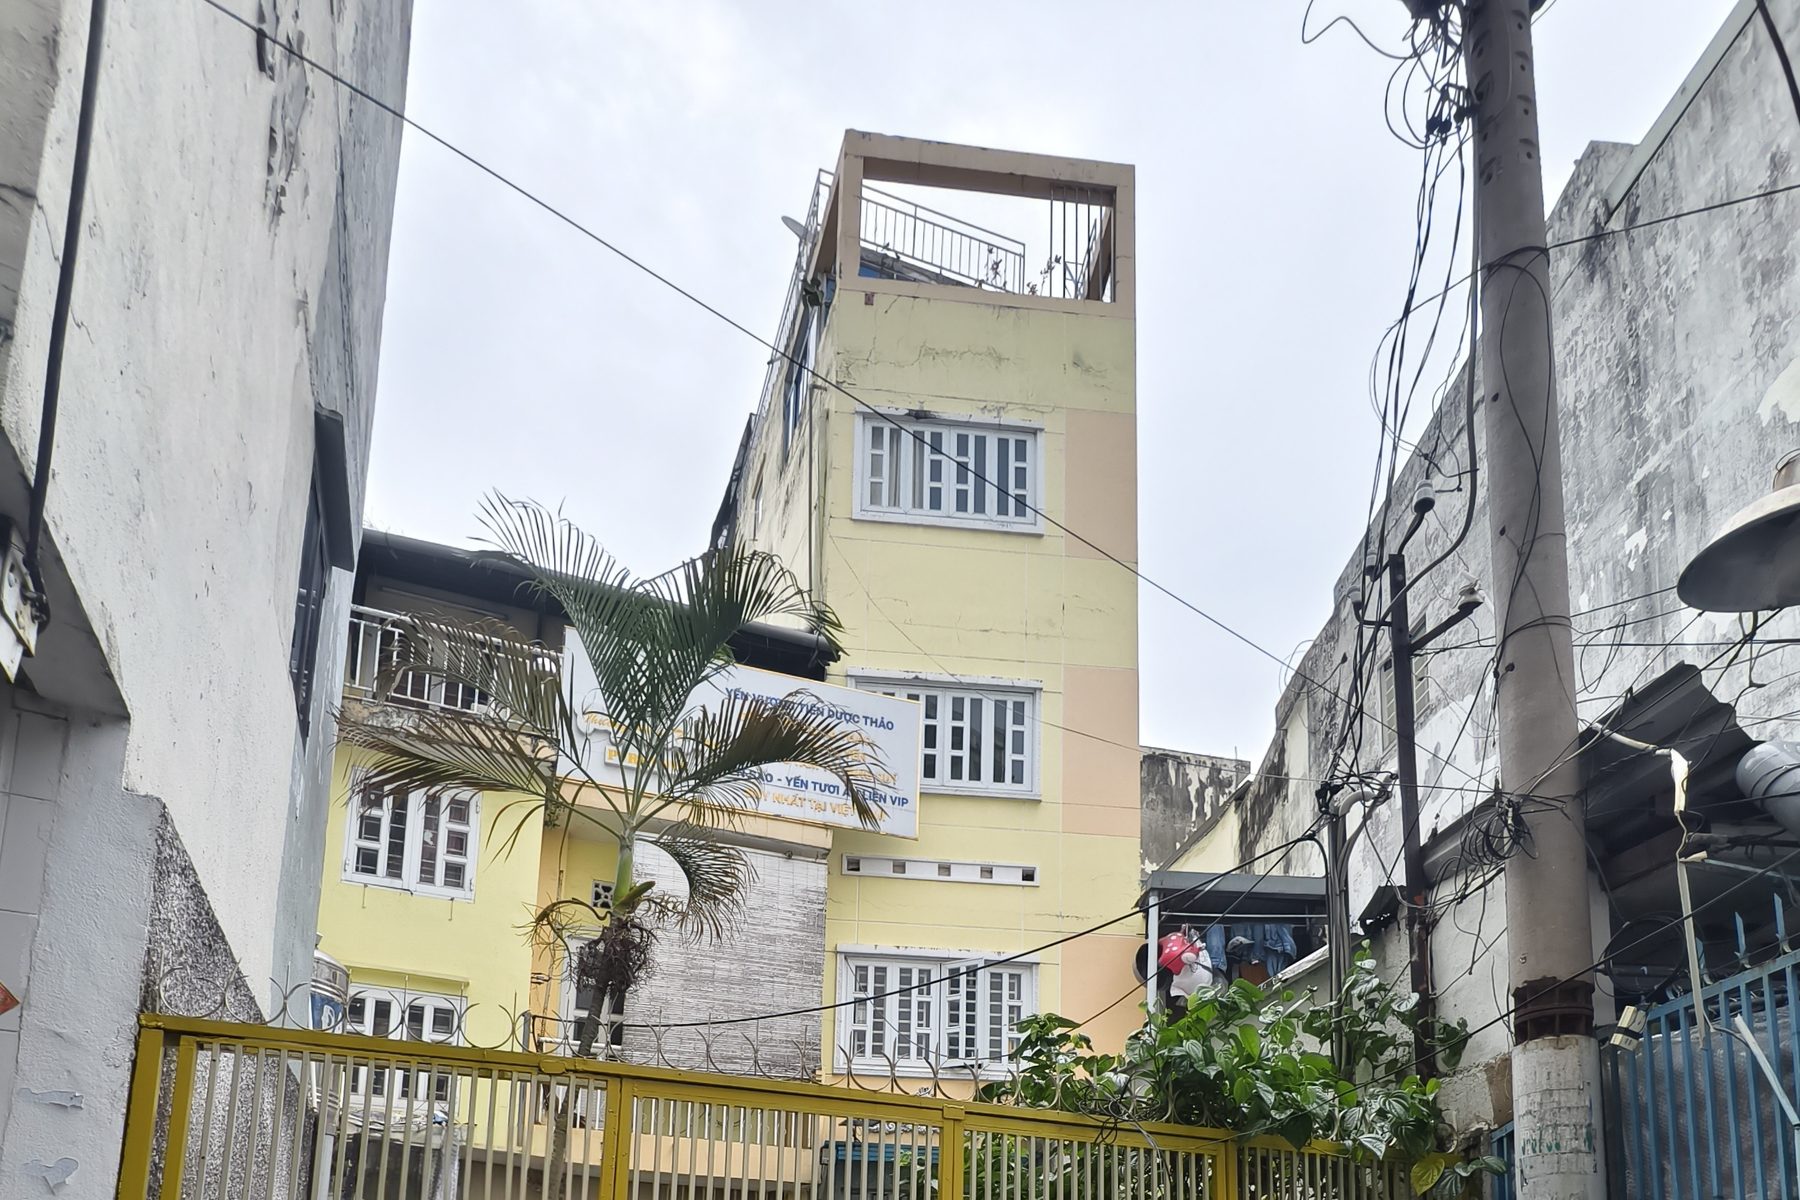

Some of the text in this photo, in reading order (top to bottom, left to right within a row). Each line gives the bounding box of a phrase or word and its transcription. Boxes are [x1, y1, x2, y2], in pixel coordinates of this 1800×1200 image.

[862, 715, 894, 731] THẢO
[785, 775, 808, 790] YẾN
[811, 781, 840, 795] TƯƠI
[890, 795, 909, 807] VIP
